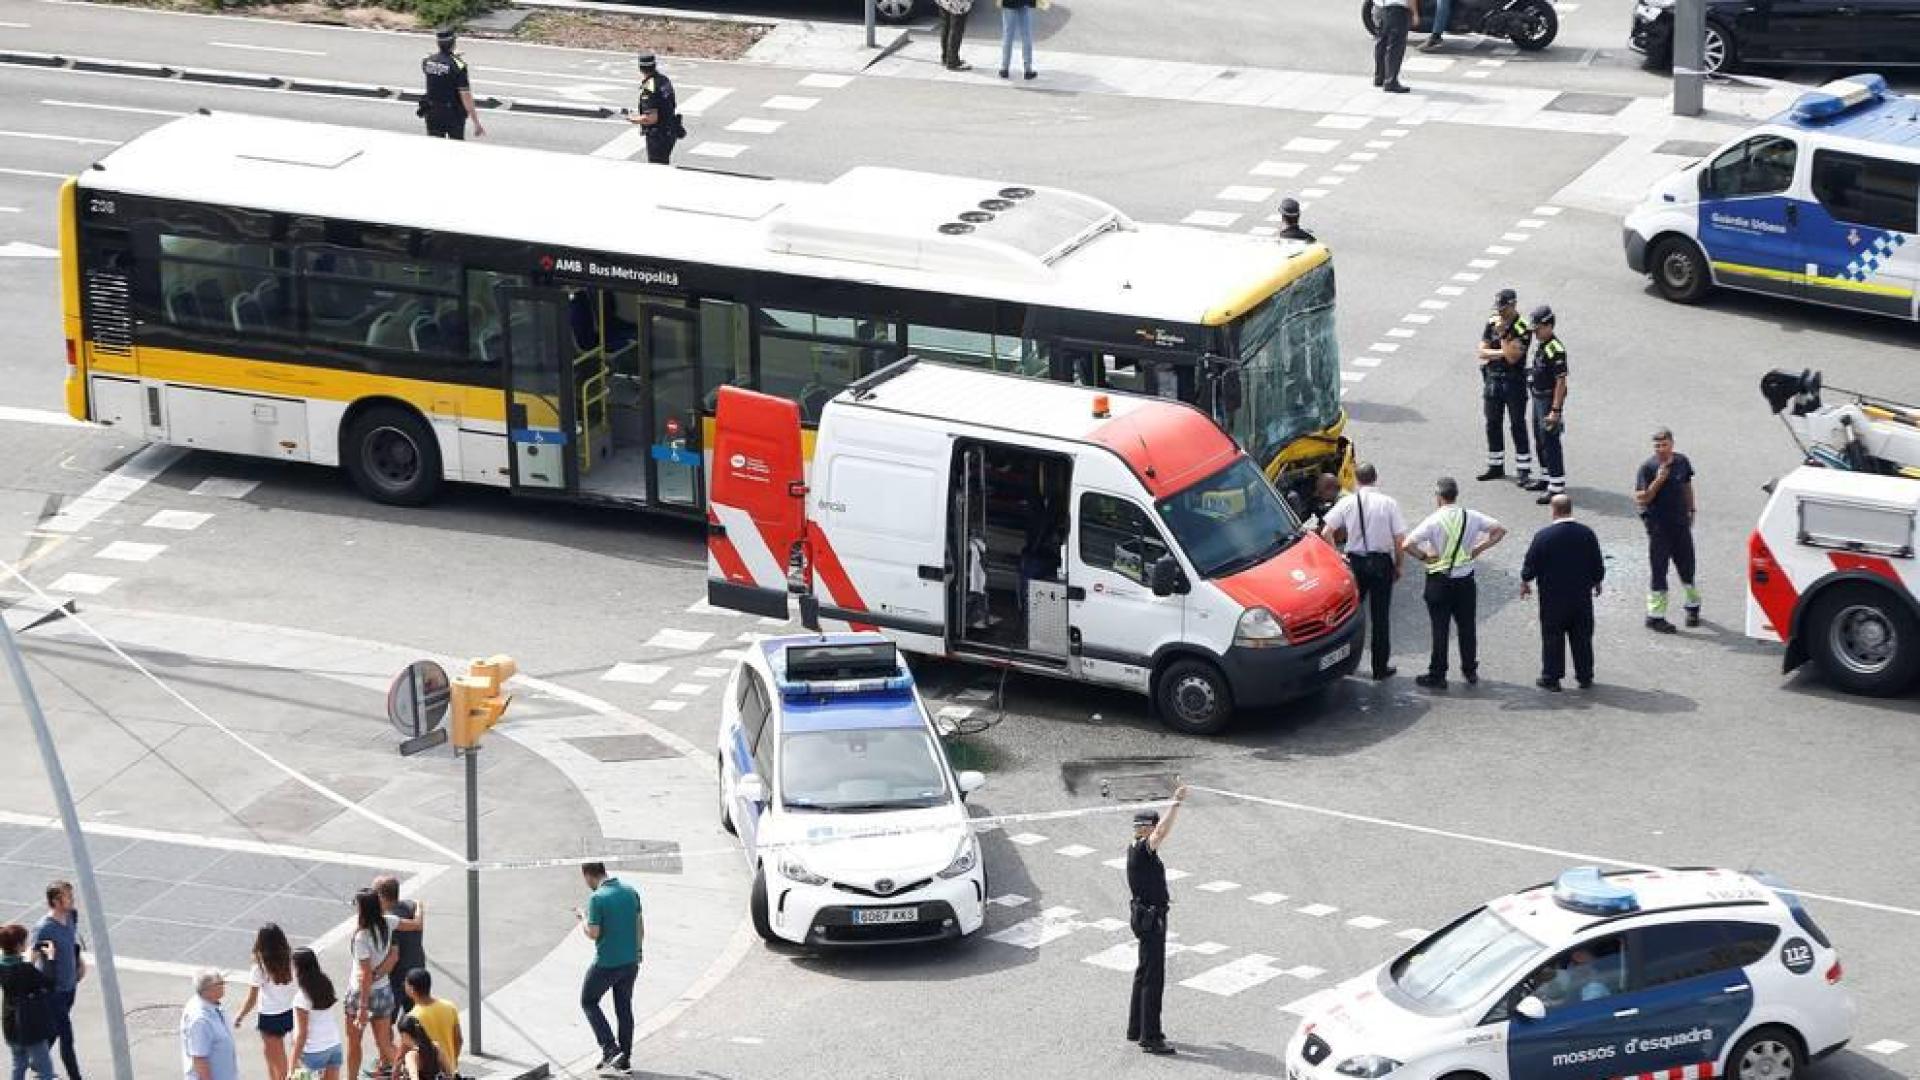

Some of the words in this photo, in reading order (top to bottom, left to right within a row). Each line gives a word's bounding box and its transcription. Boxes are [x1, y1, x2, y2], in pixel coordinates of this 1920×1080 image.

[556, 259, 583, 273] AMB
[588, 263, 610, 277] Bus
[1783, 945, 1812, 963] 112
[1552, 1044, 1617, 1067] mossos
[1624, 1026, 1714, 1055] d'esquadra
